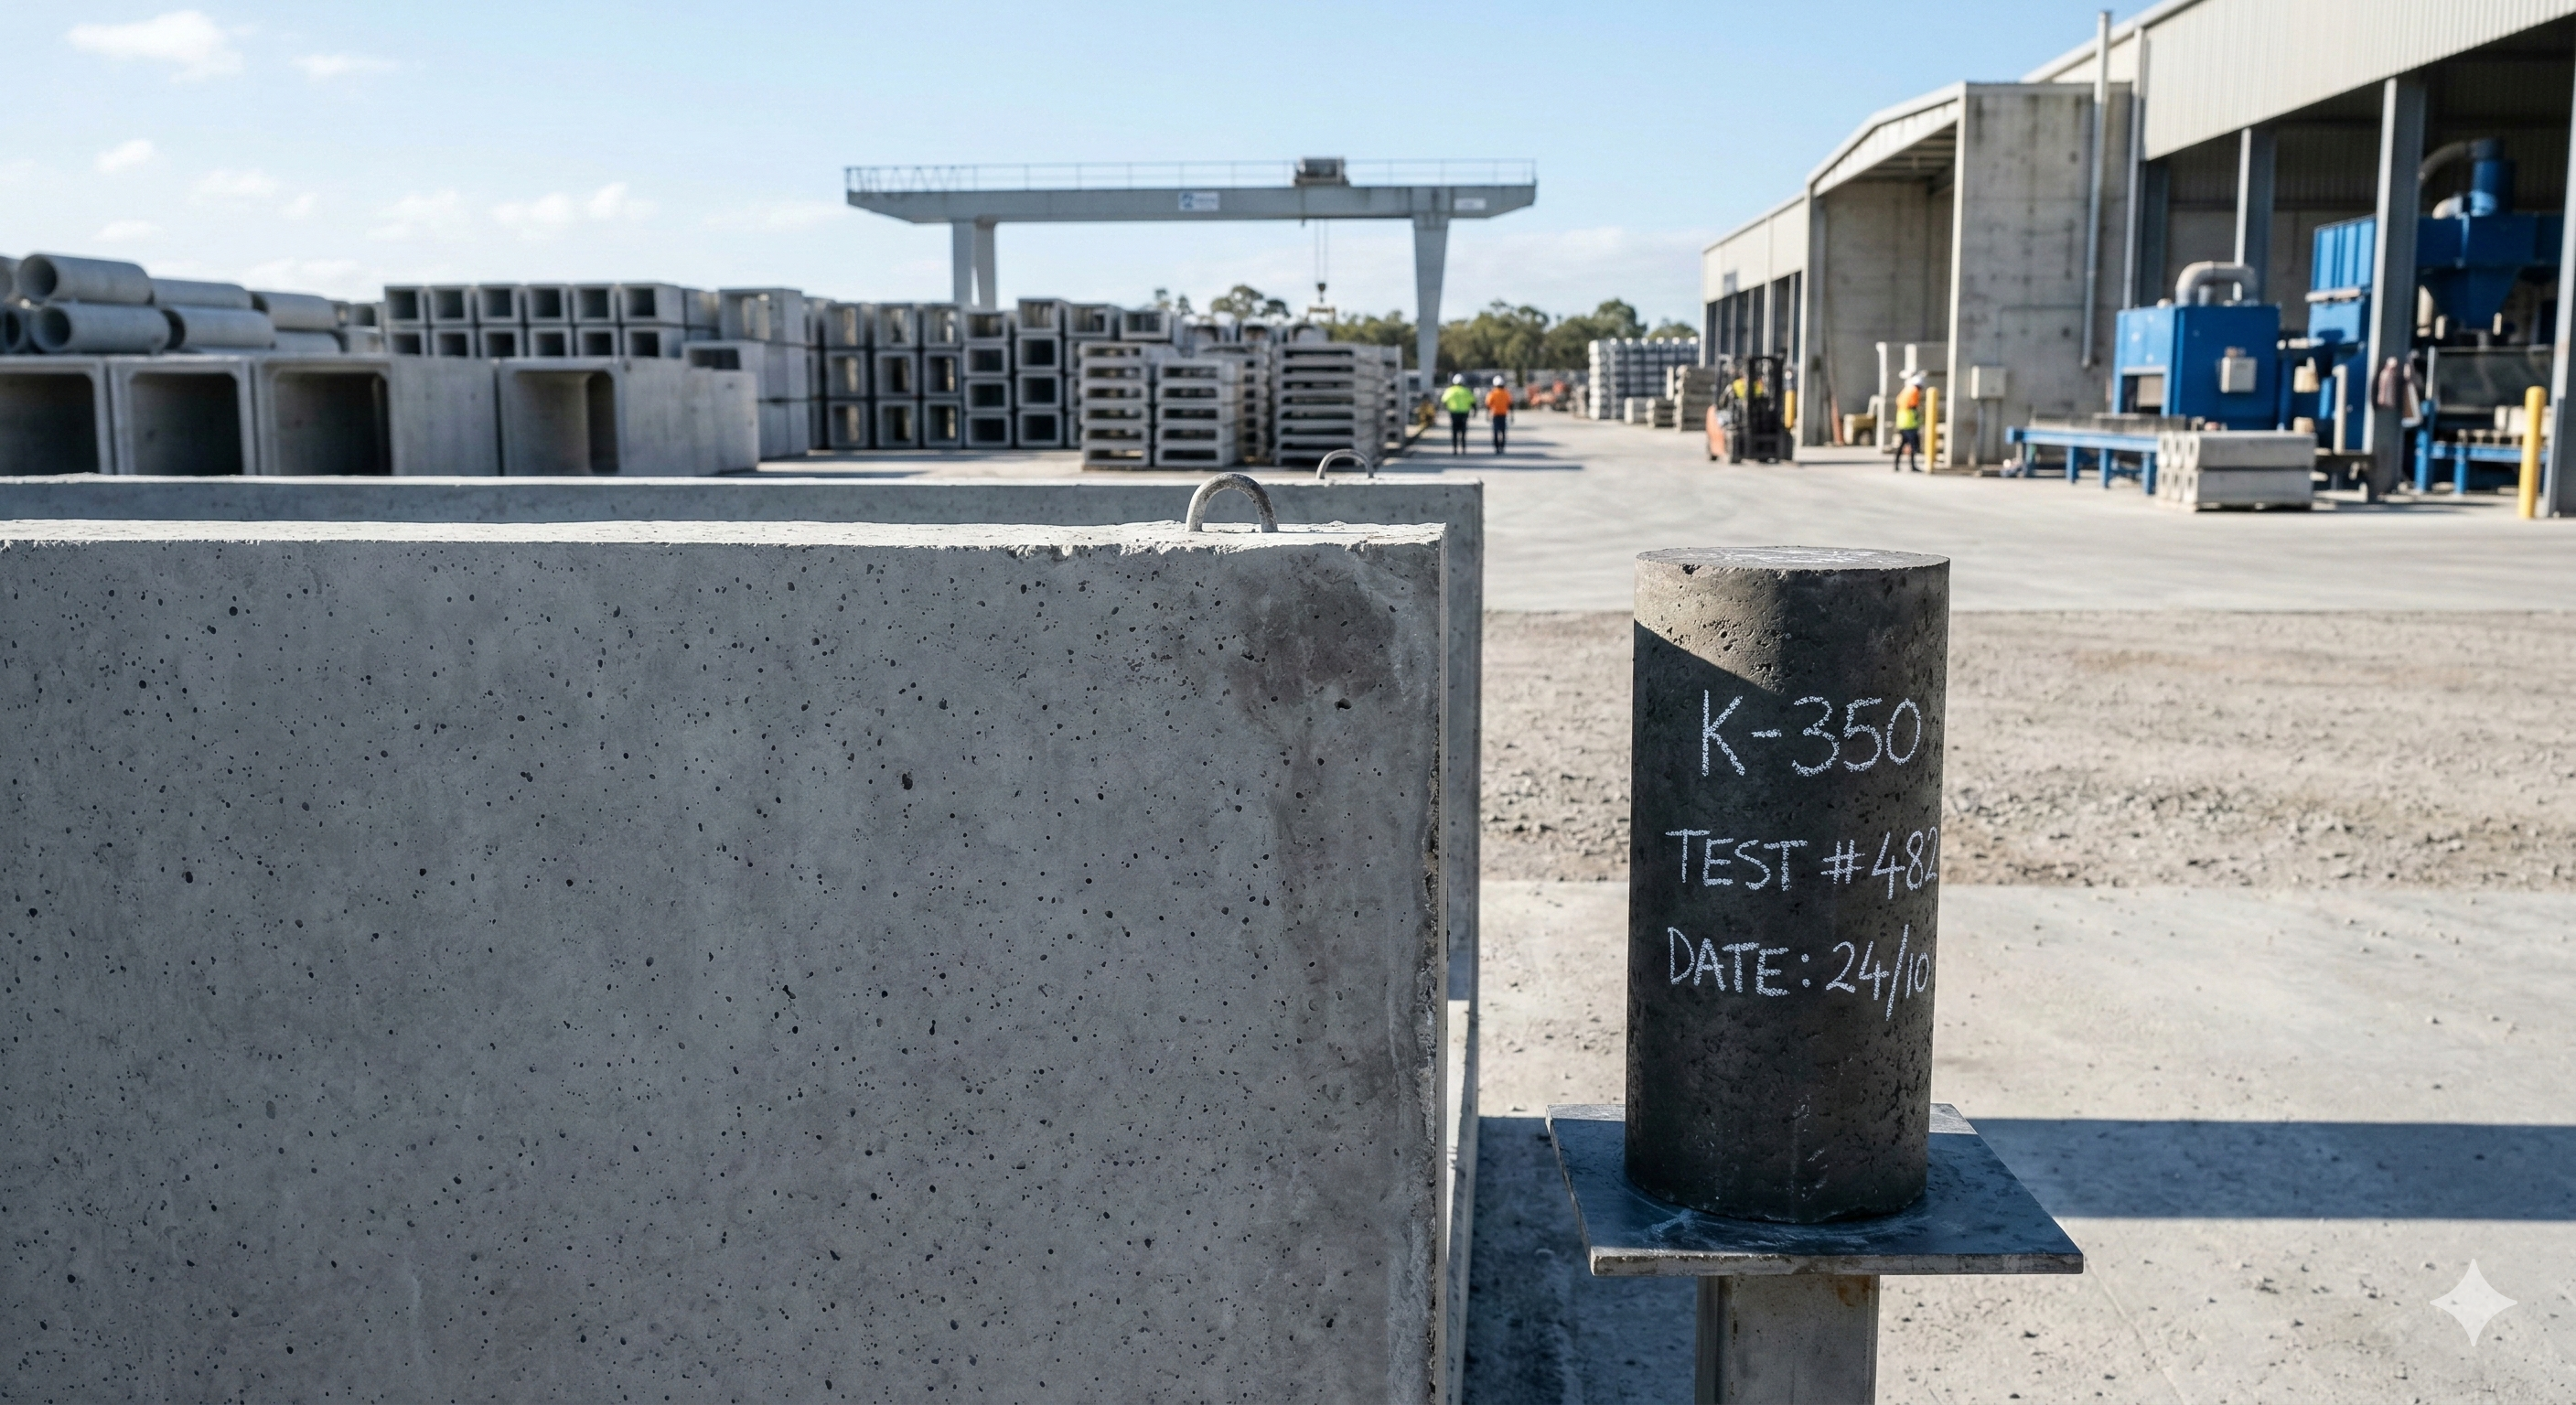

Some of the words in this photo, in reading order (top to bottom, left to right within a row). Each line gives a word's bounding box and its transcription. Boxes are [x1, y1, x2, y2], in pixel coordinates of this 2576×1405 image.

[1701, 690, 1921, 776] K-350
[1665, 829, 1808, 891] TEST
[1820, 826, 1937, 899] #482
[1668, 927, 1810, 997] DATE:
[1826, 924, 1929, 1021] 24/10
